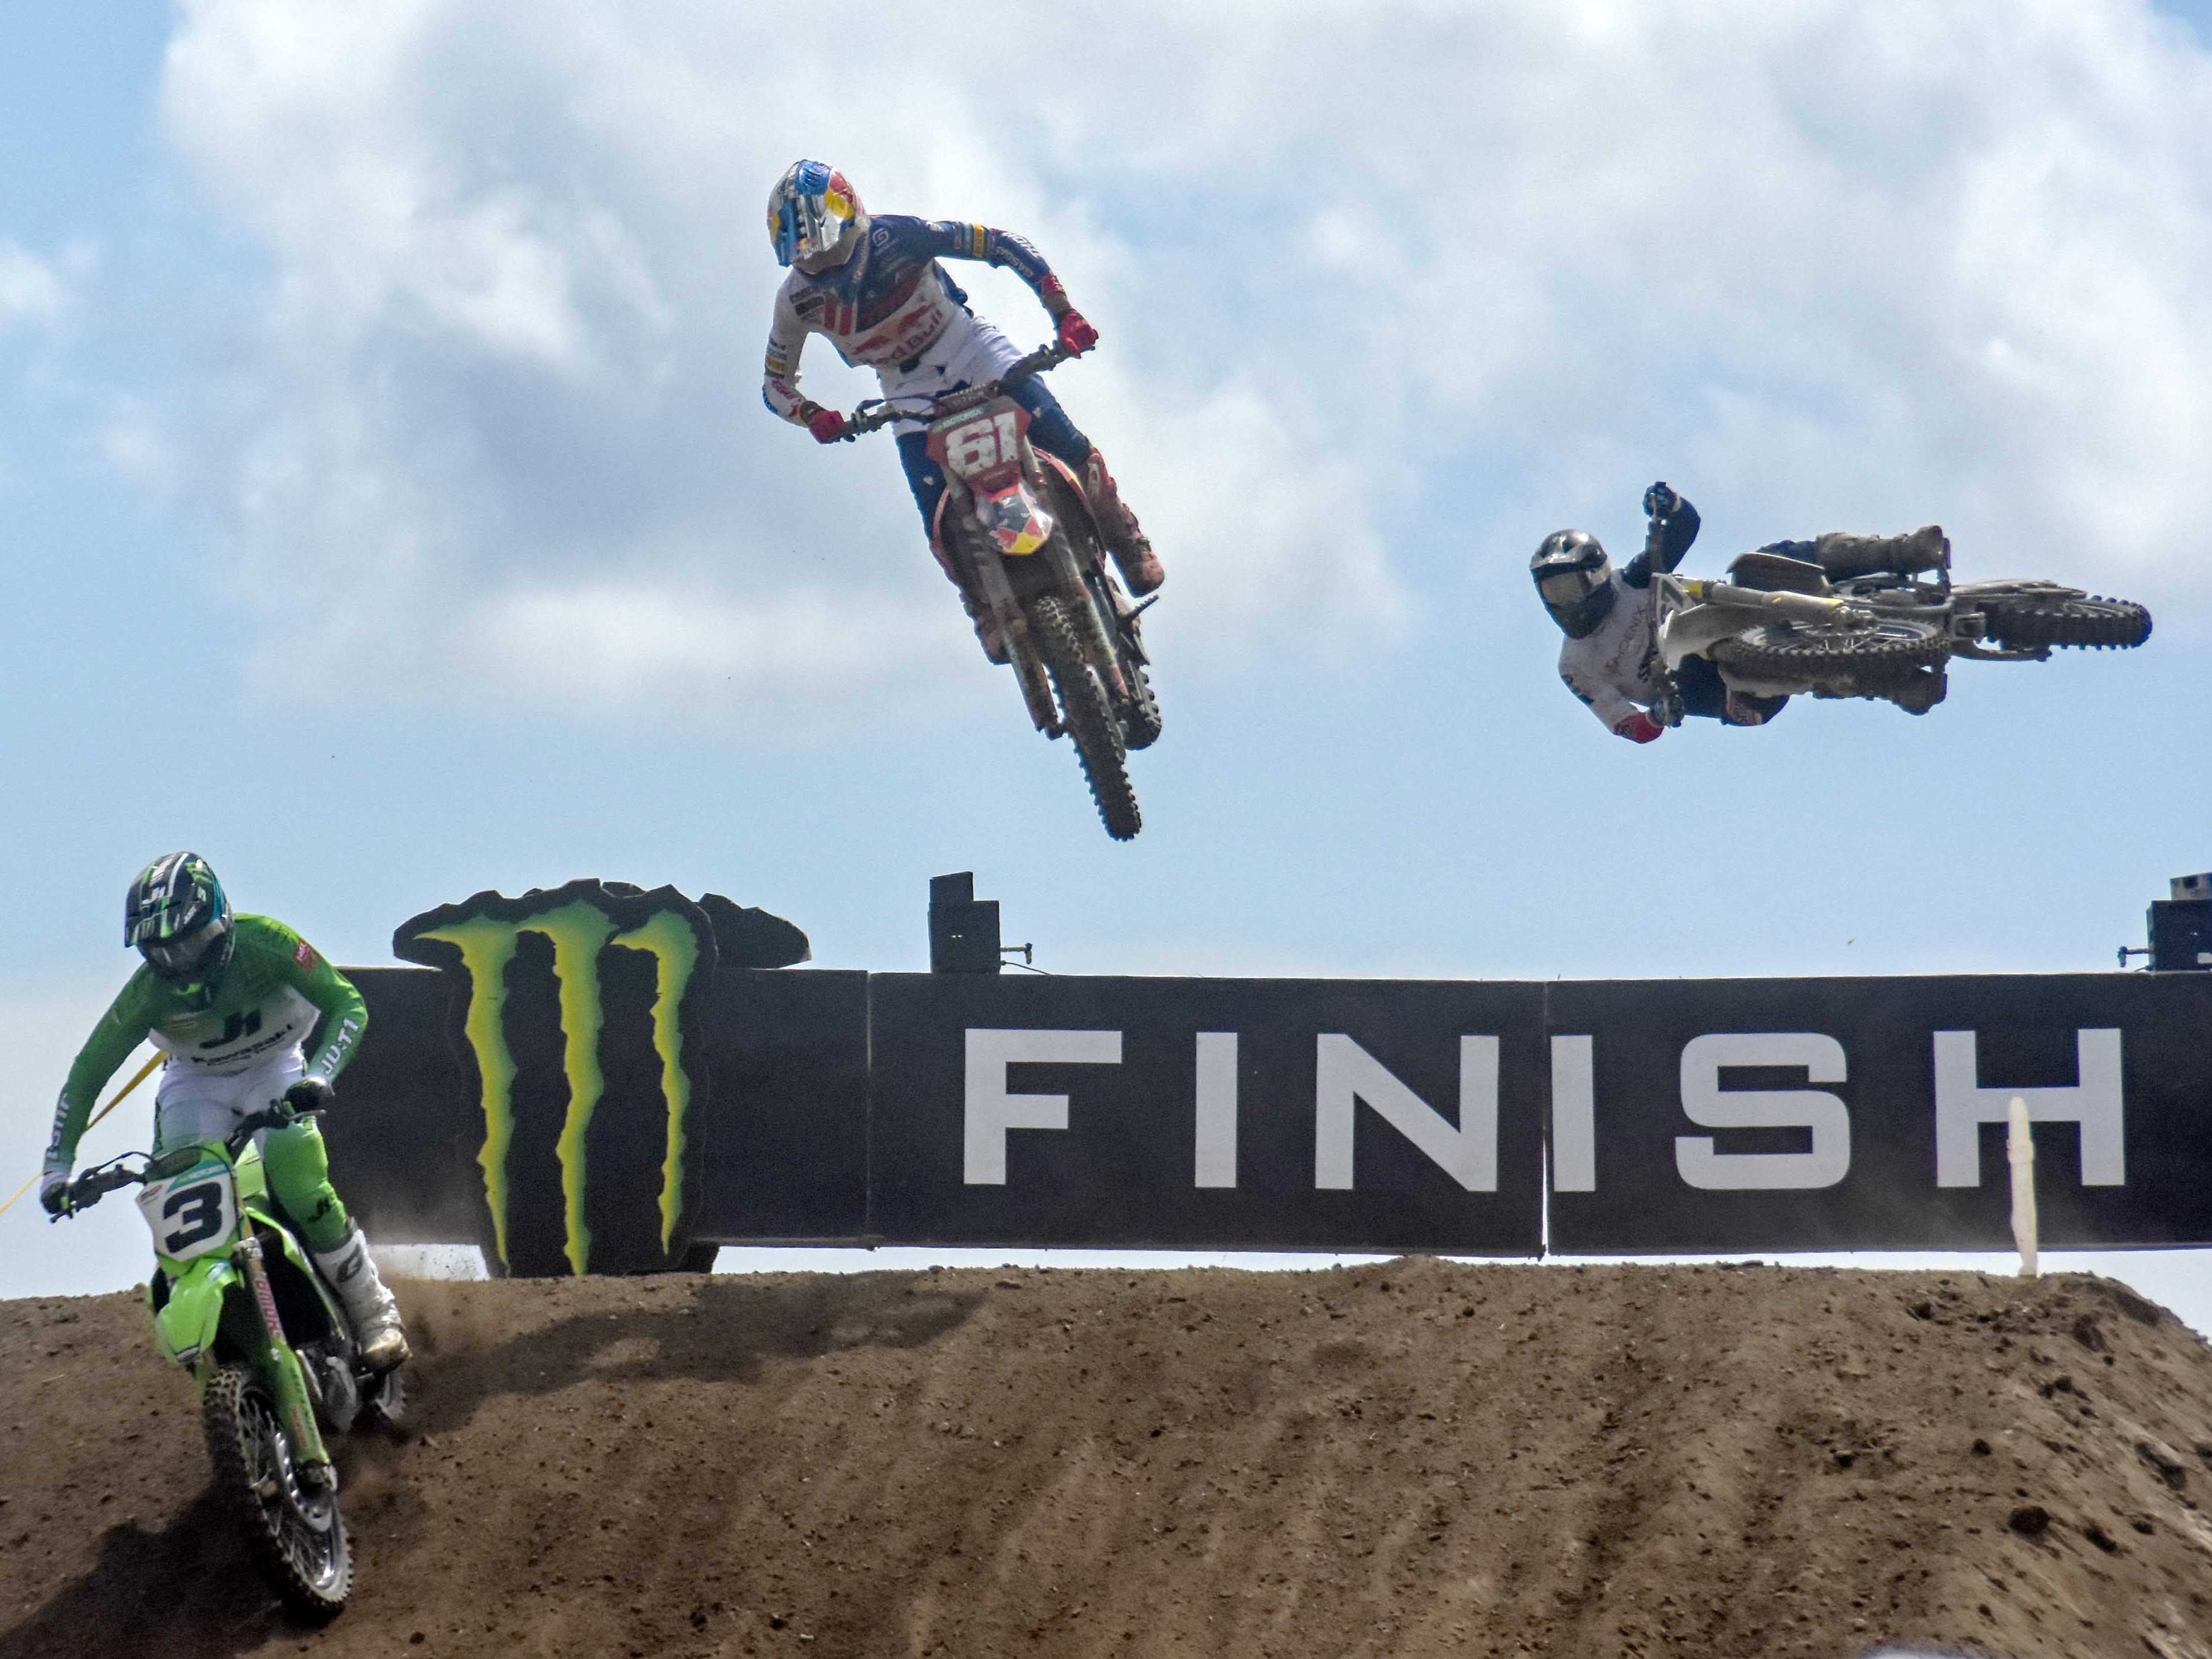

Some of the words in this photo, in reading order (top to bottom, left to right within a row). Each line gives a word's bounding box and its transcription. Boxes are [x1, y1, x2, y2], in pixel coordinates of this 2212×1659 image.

[946, 411, 1018, 476] 61
[964, 1027, 2126, 1192] FINISH
[163, 1182, 222, 1253] 3
